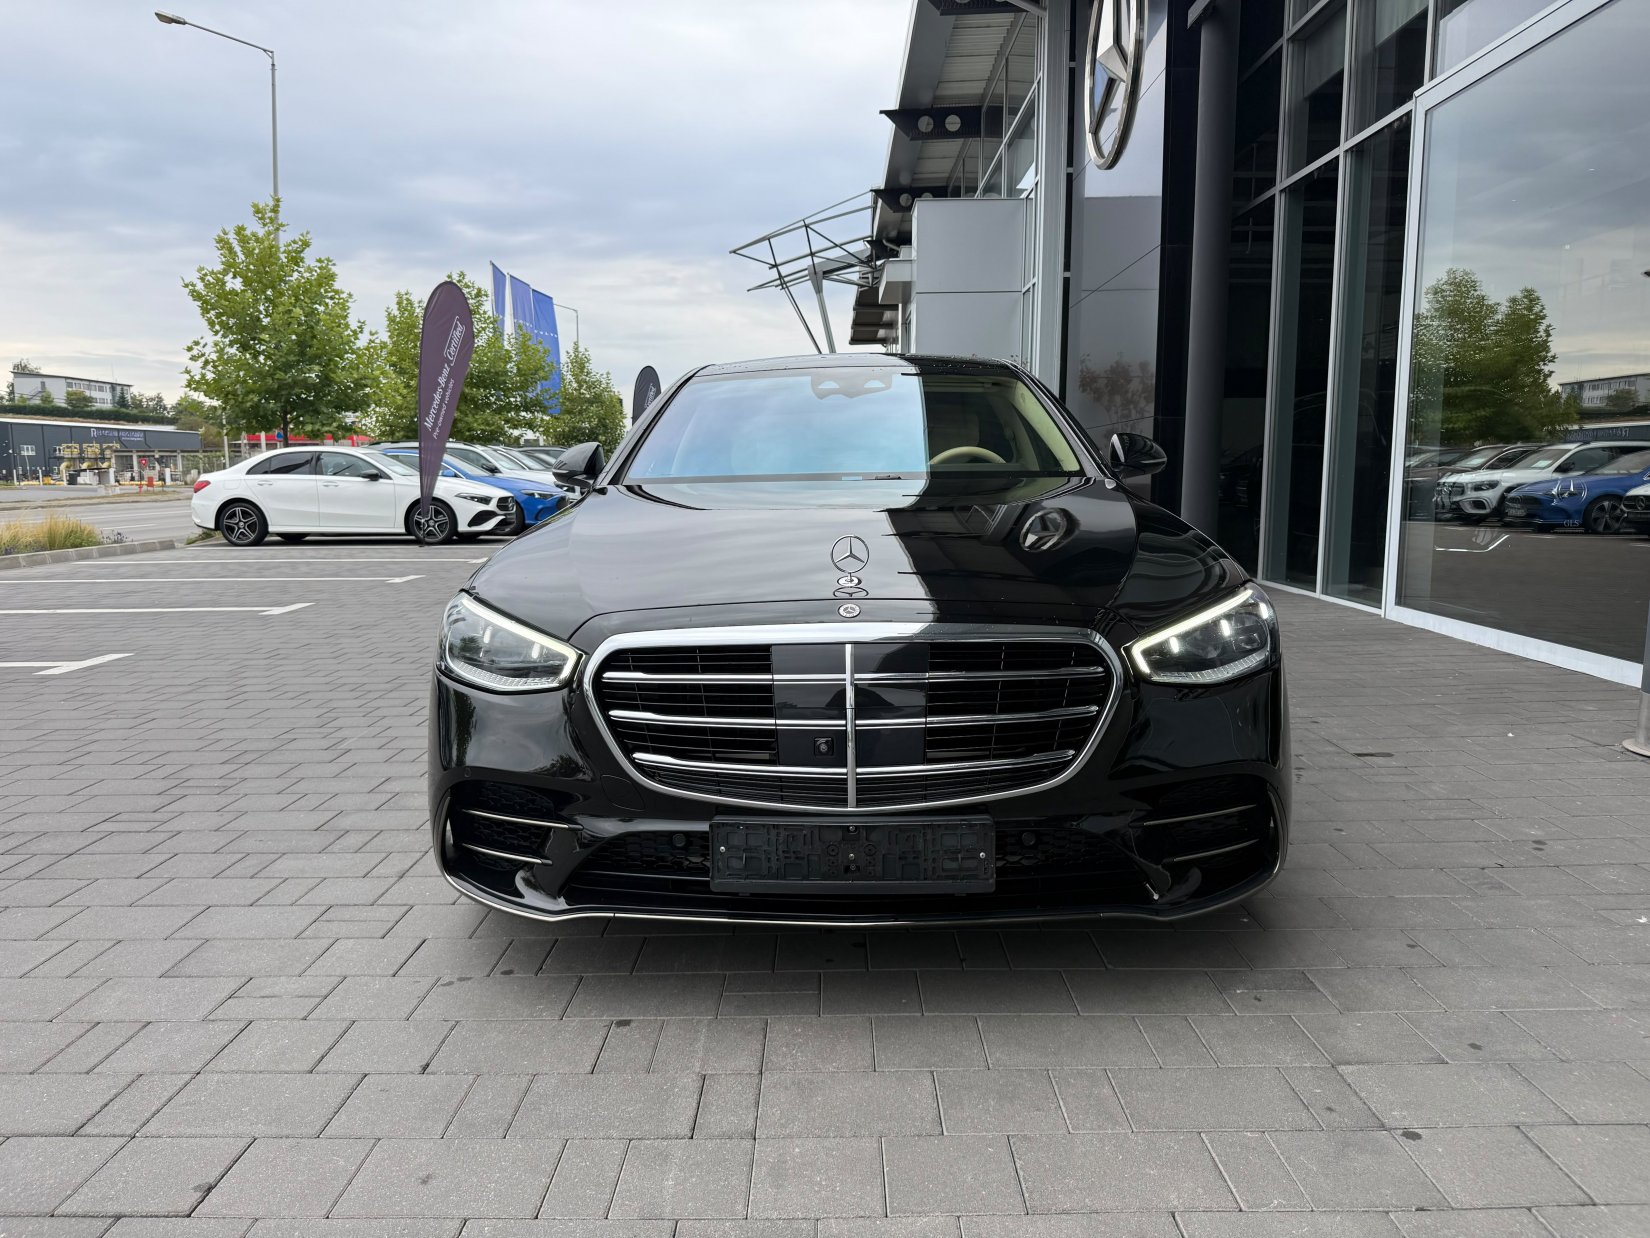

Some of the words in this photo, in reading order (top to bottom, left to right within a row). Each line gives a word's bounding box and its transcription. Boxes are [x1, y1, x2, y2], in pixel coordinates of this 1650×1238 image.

[424, 363, 450, 431] Mercedes-Benz
[447, 321, 464, 360] Certified
[433, 403, 447, 440] Pre-owned
